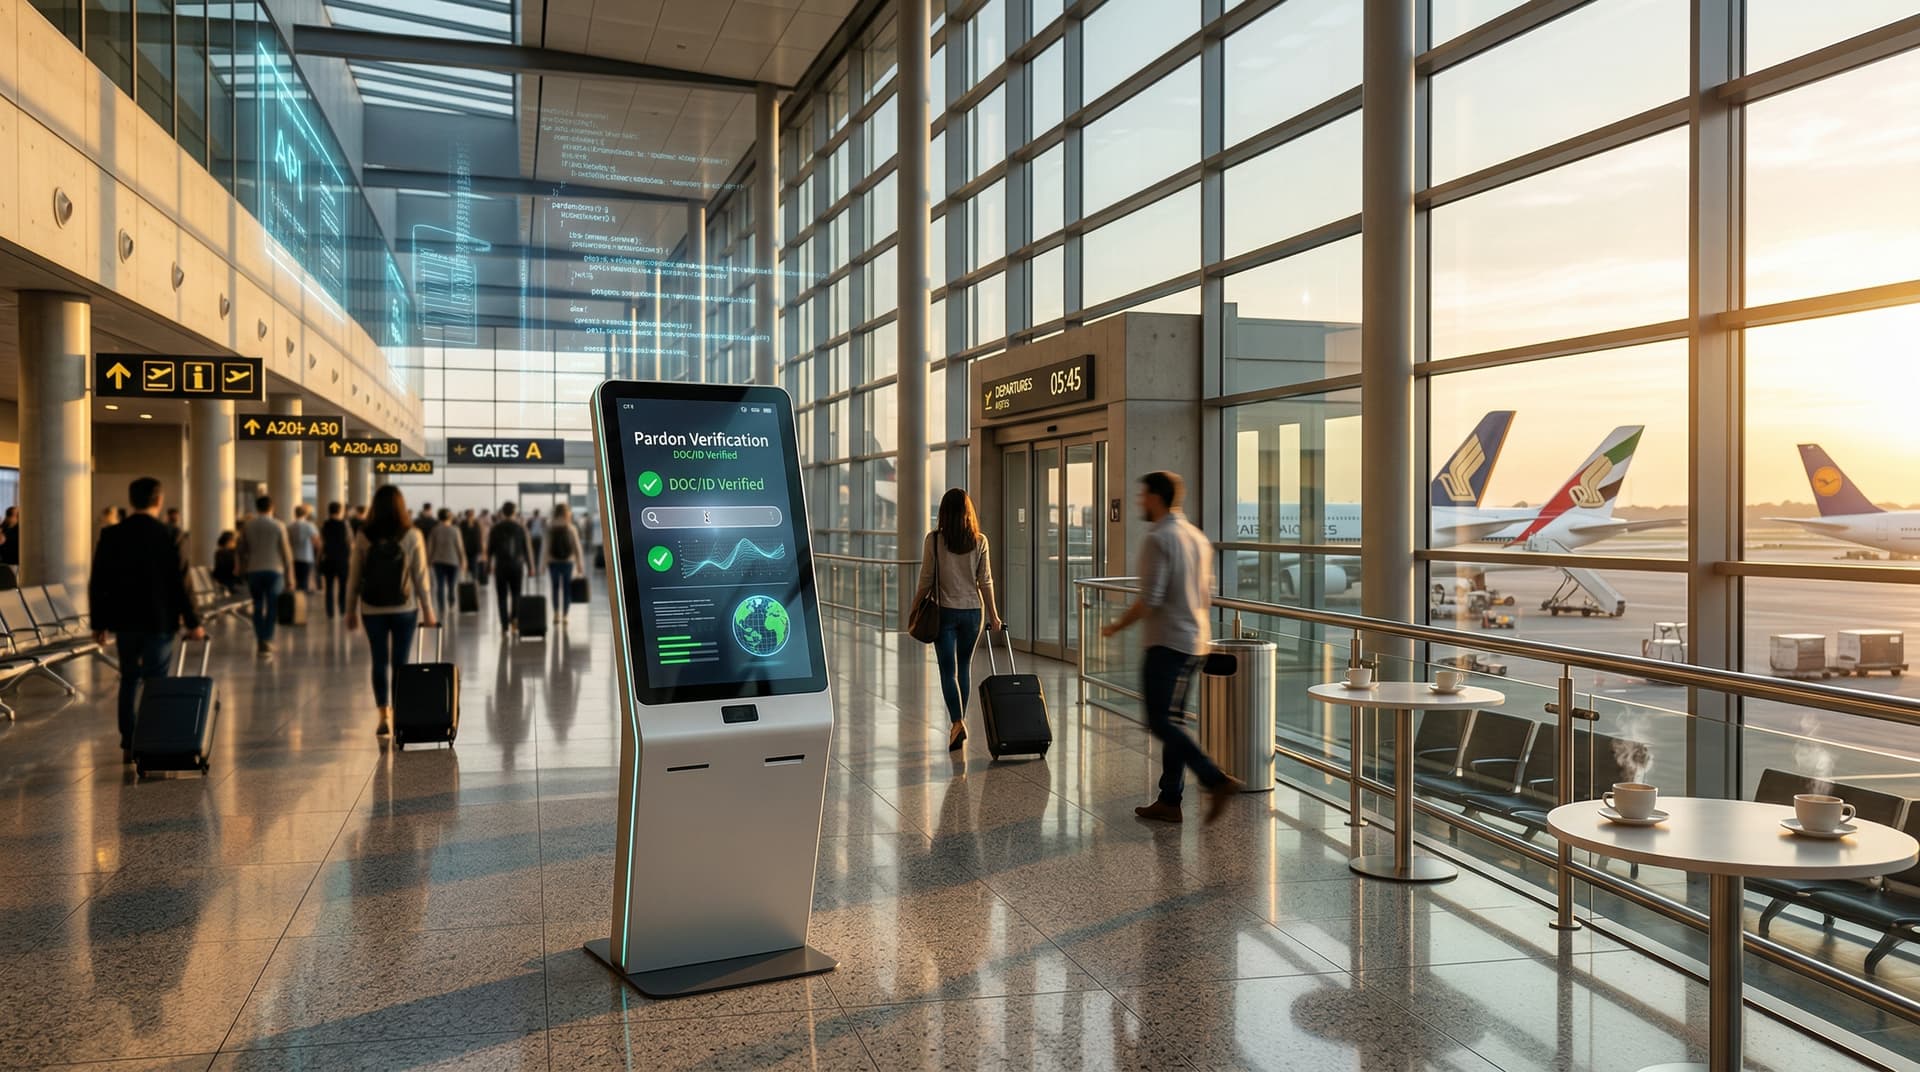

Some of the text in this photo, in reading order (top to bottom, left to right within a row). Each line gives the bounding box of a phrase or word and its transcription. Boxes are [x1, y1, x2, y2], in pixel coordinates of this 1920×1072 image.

[1050, 366, 1081, 396] 05:45
[308, 422, 339, 435] A30
[634, 432, 769, 447] Pardon Verification
[472, 442, 542, 459] GATES A
[673, 450, 738, 460] DOC/ID Verified
[669, 477, 765, 492] DOC/ID Verified
